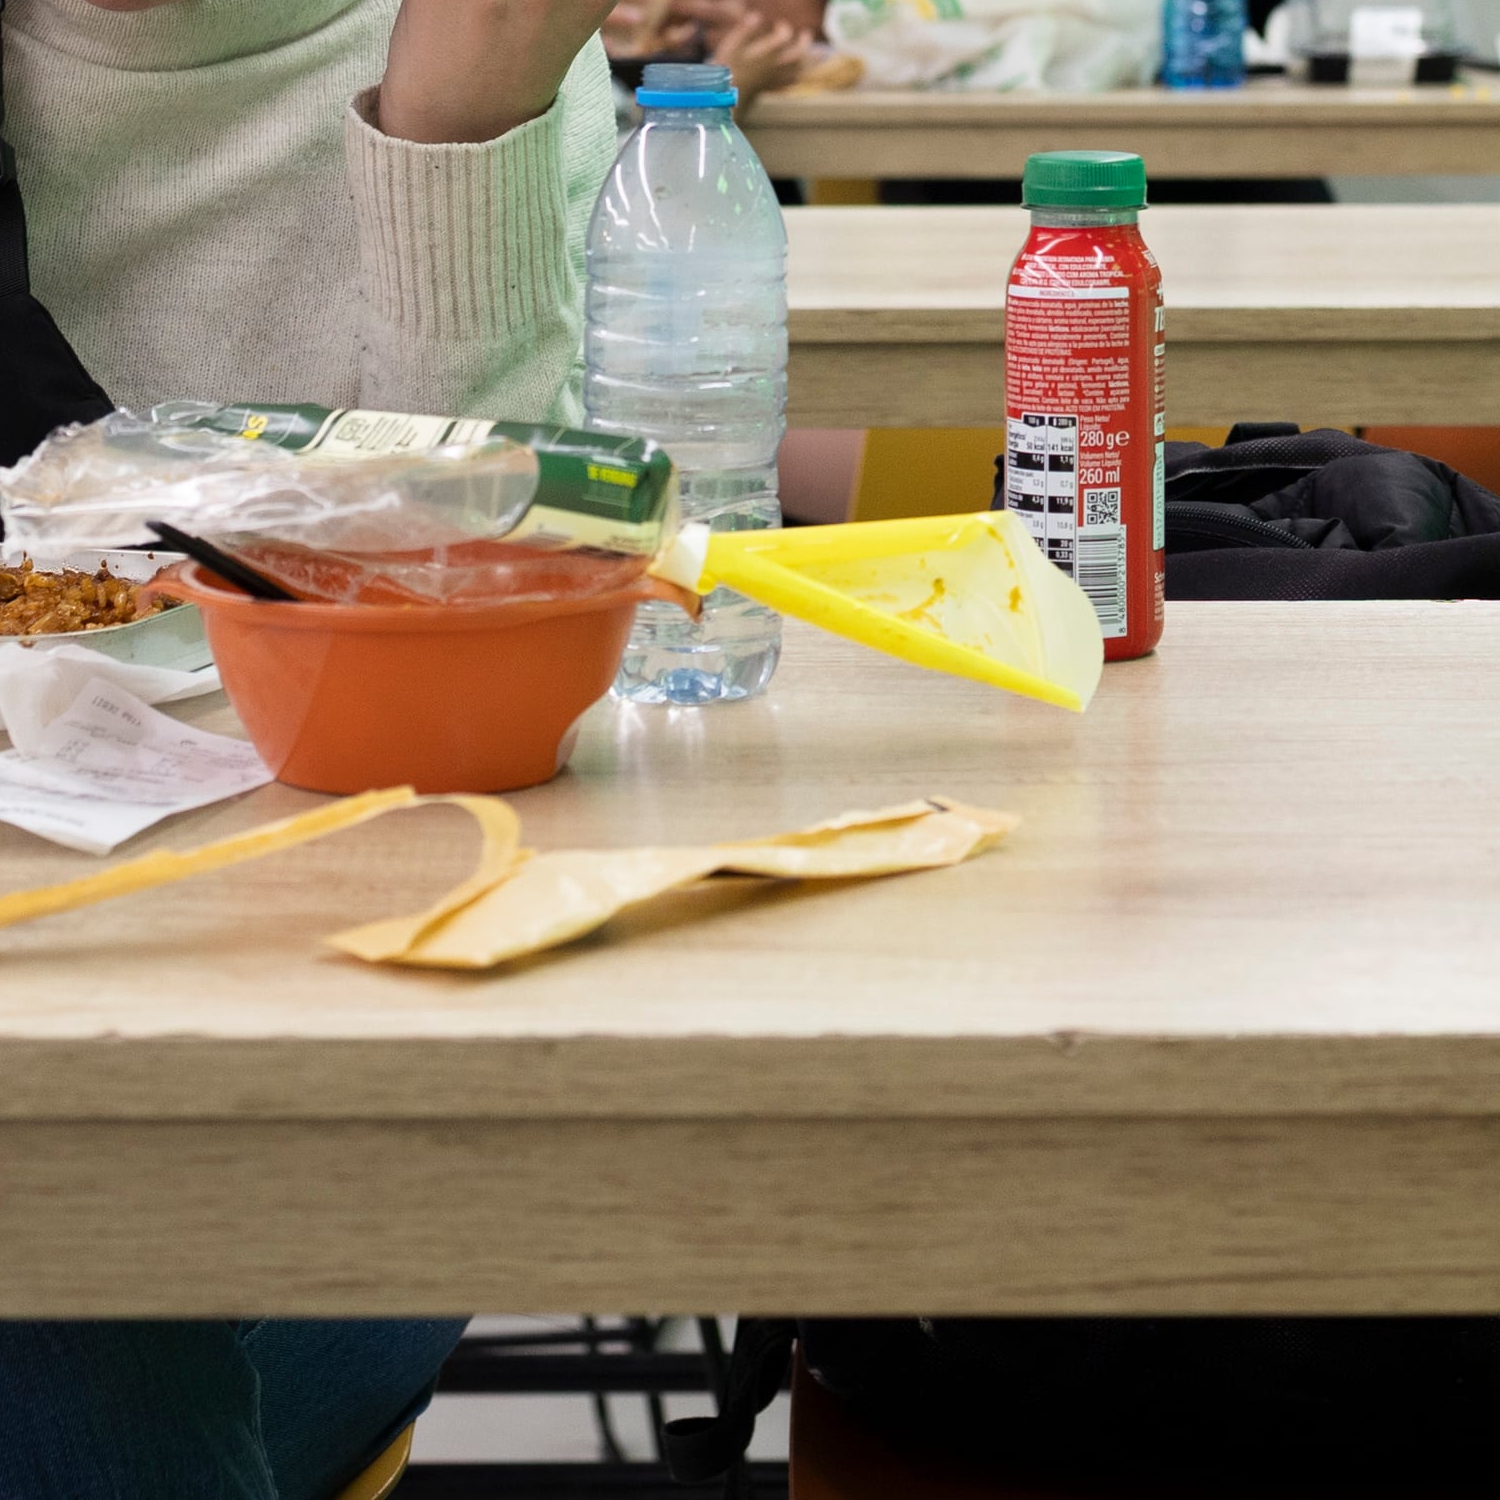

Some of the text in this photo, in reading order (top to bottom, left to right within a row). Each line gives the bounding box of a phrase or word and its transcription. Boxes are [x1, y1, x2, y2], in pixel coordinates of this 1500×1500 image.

[1060, 443, 1074, 452] kcal
[1080, 430, 1104, 447] 280
[1079, 465, 1120, 485] 260 ml
[1117, 537, 1126, 576] 213785
[1117, 581, 1126, 620] 480000
